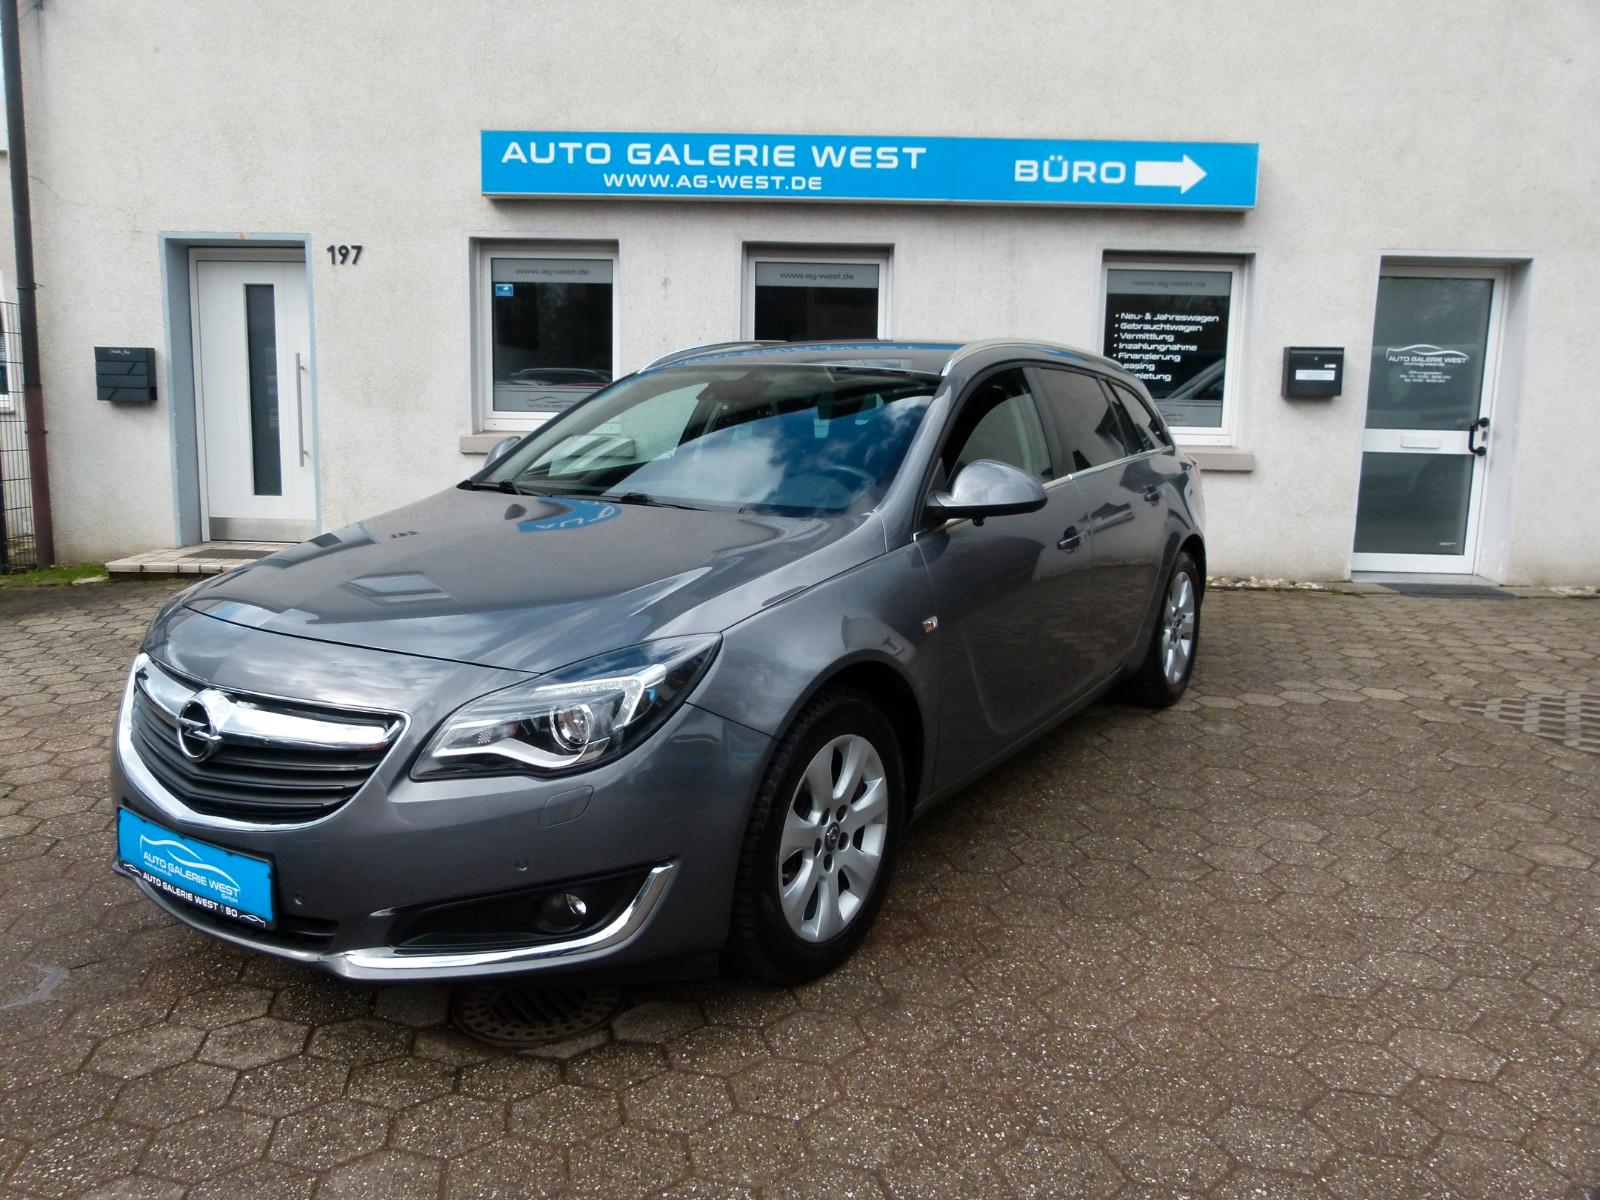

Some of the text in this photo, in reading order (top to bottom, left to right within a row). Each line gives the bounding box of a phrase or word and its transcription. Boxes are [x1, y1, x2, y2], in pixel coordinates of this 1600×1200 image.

[501, 141, 927, 169] AUTO GALERIE WEST
[1014, 154, 1126, 184] BÜRO
[603, 173, 822, 190] WWW.AG-WEST.DE
[326, 245, 363, 265] 197
[1120, 312, 1219, 323] Neu- & Jahreswagen
[1120, 322, 1203, 333] Gebrauchtwagen
[1119, 332, 1174, 342] Vermittlung
[1118, 343, 1198, 352] Inzahlungnahme
[1118, 352, 1181, 362] Finanzierung
[1388, 355, 1410, 363] AUTO
[1121, 362, 1155, 371] easing
[143, 851, 167, 869] AUTO
[168, 862, 208, 887] GALERIE
[208, 878, 240, 898] WEST
[142, 872, 161, 887] AUTO
[162, 882, 193, 902] GALERIE
[194, 896, 219, 910] WEST
